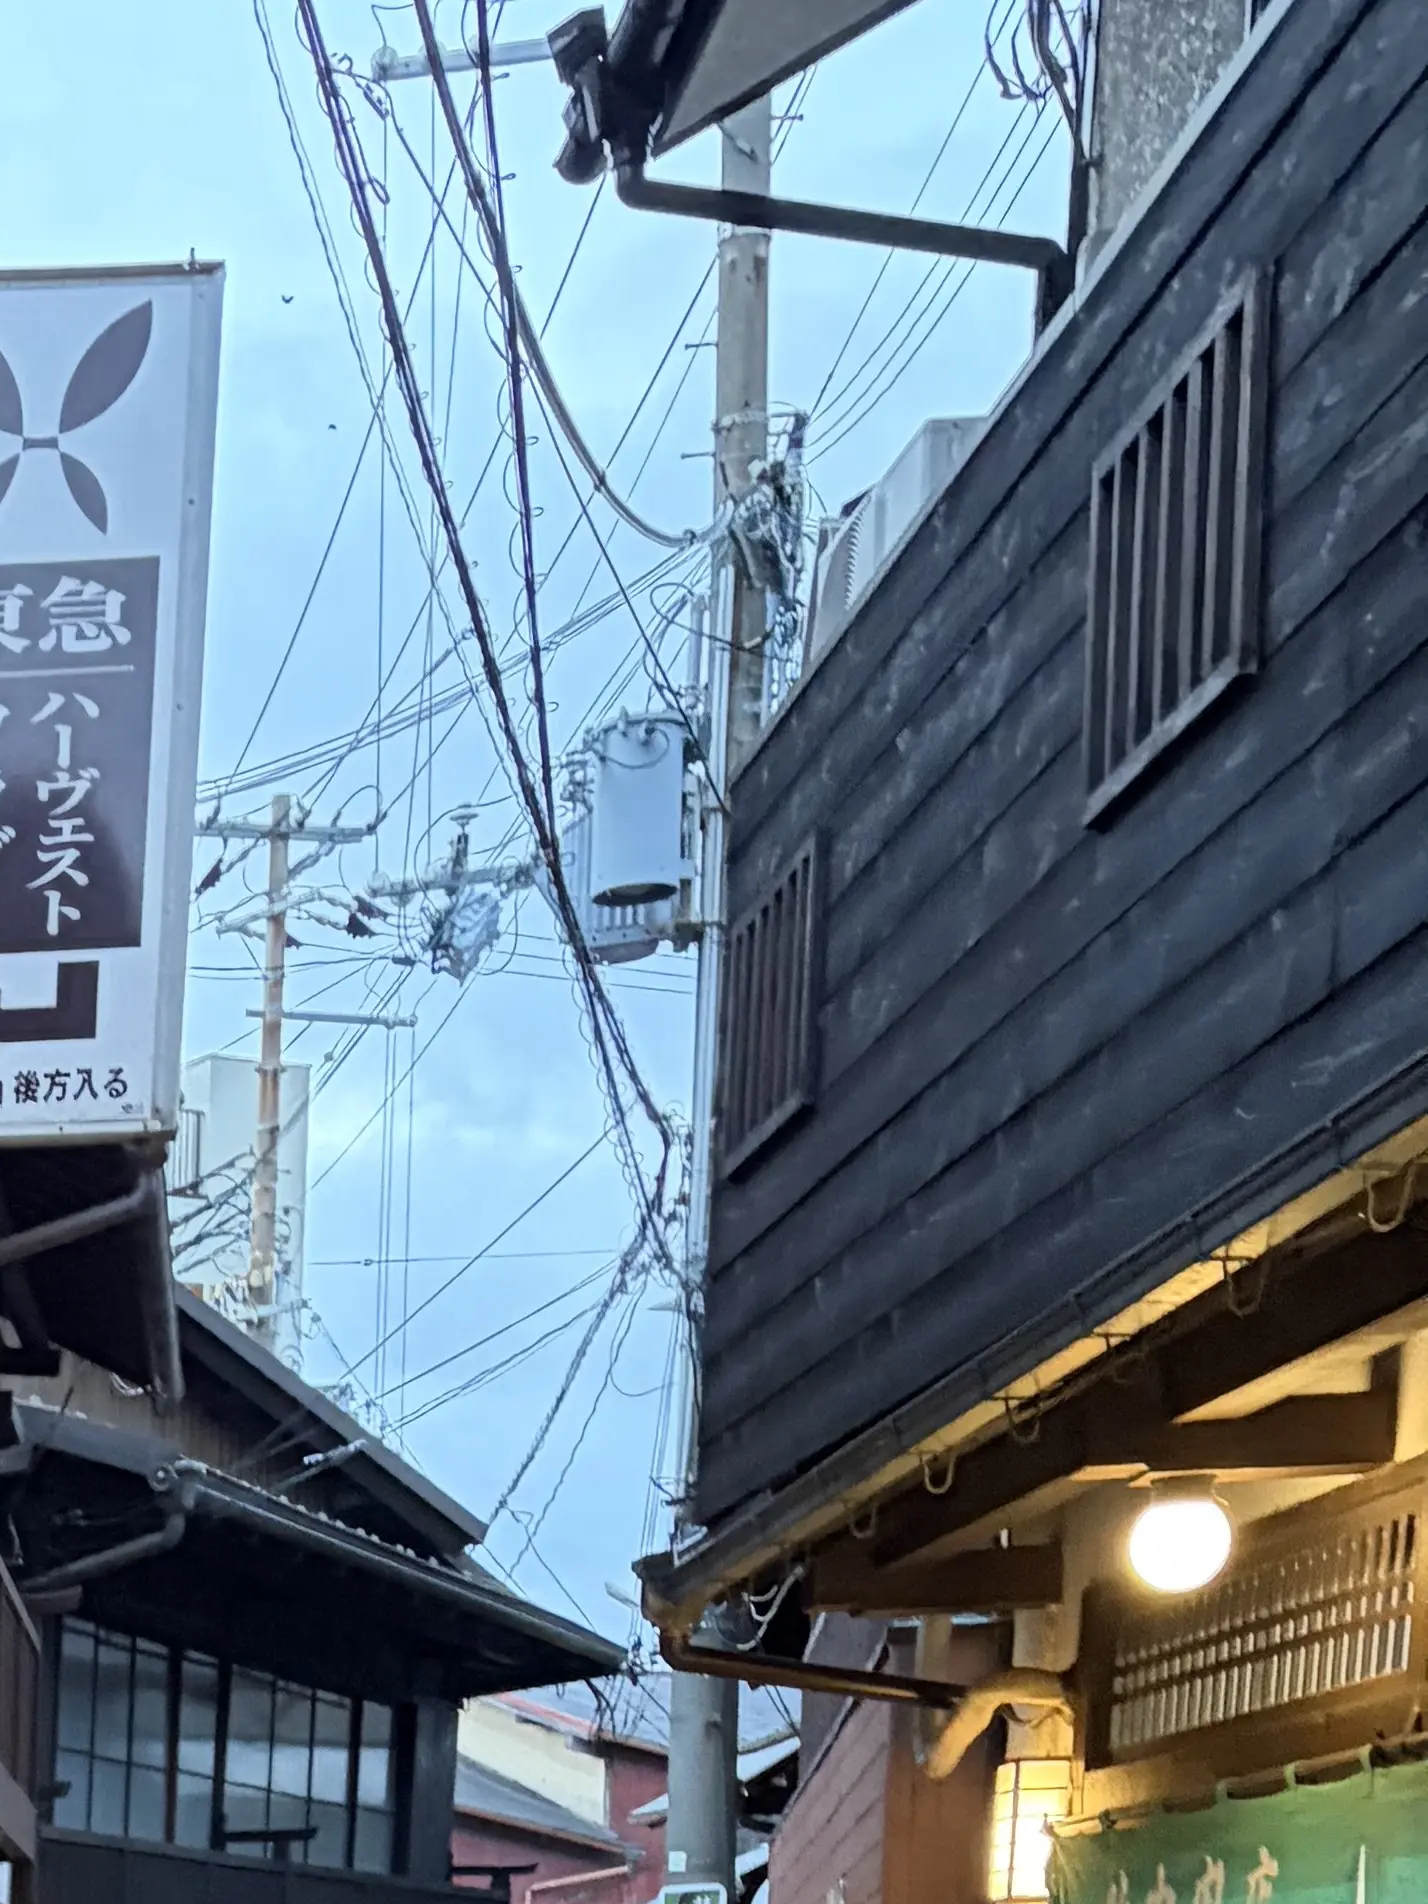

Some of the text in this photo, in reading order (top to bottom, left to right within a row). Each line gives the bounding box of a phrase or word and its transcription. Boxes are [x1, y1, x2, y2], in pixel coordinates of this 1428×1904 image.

[26, 691, 101, 938] ハーヴェスト
[13, 1066, 129, 1105] 後方入る
